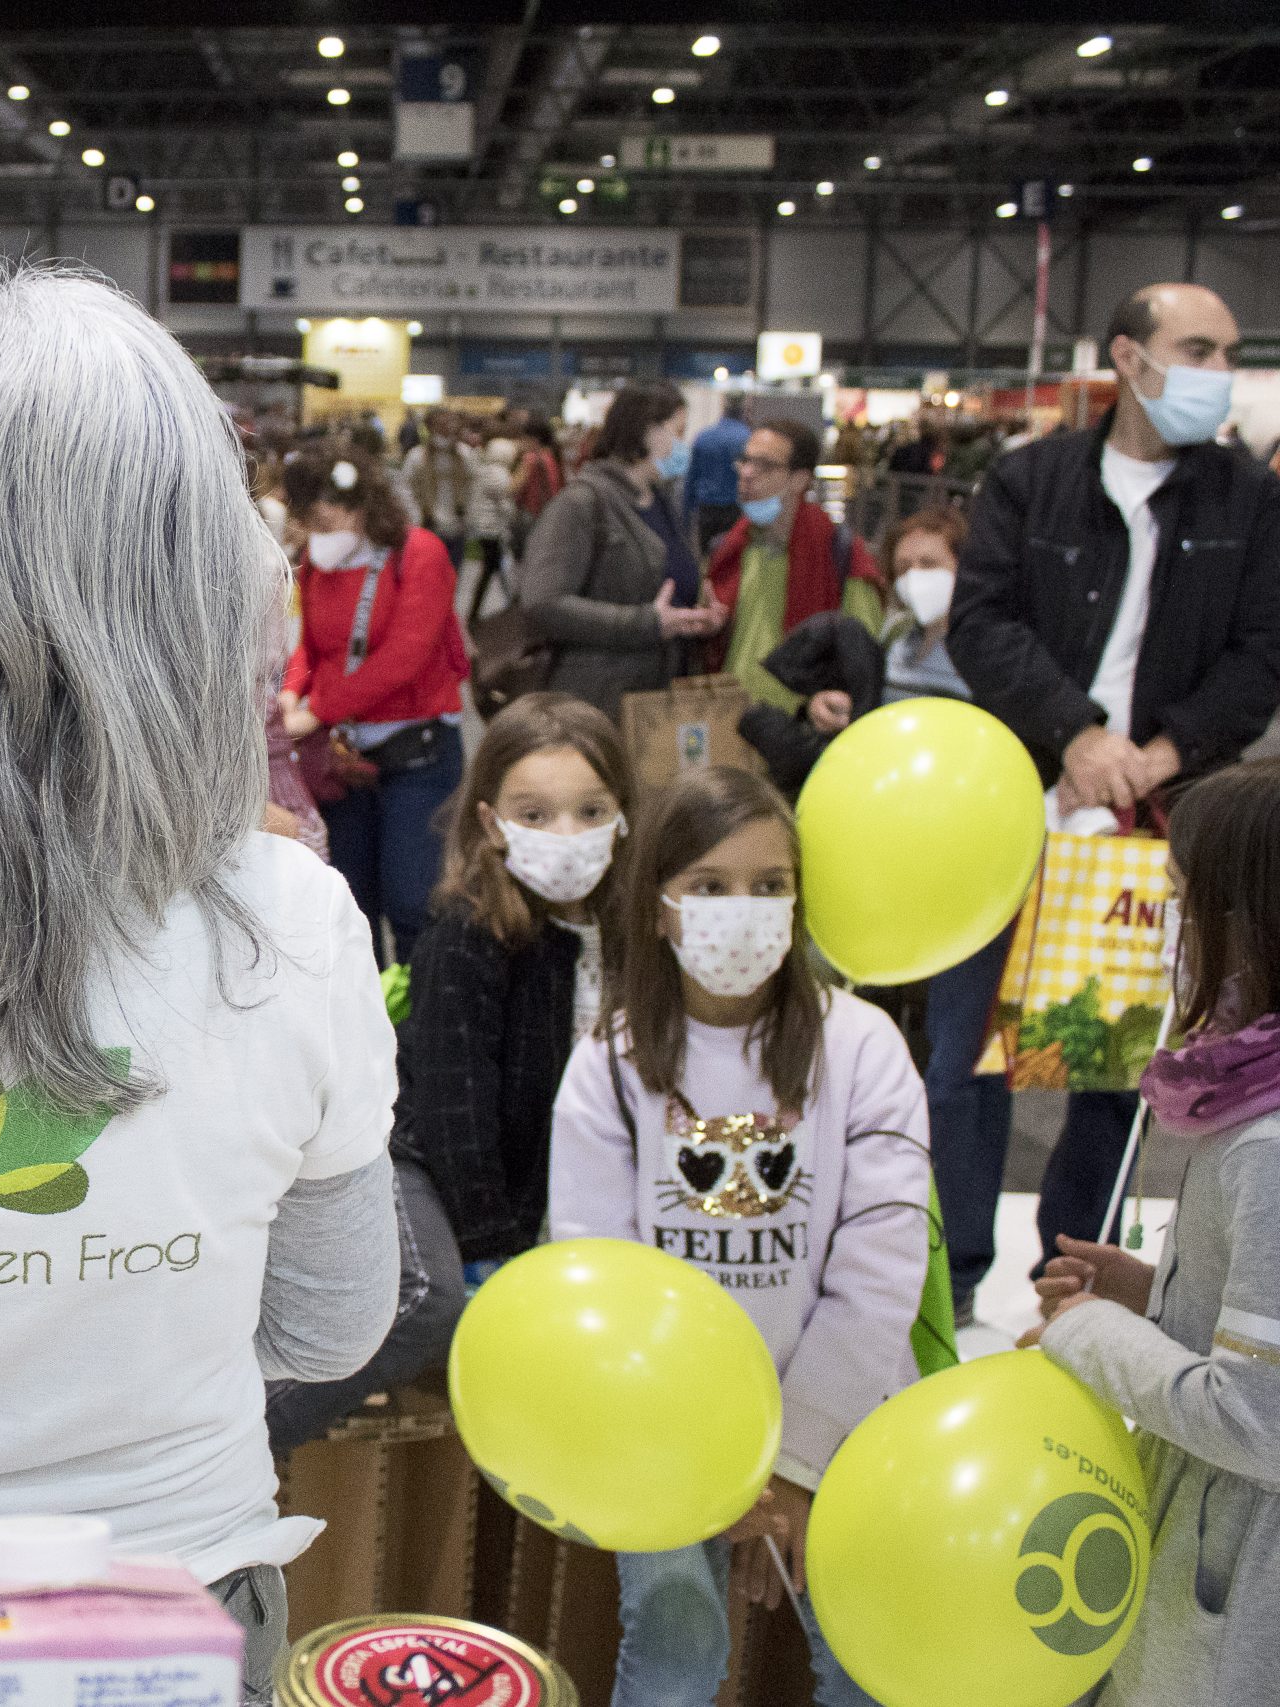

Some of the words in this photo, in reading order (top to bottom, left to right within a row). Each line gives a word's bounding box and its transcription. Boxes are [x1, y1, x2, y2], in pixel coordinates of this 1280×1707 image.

[439, 63, 466, 100] 9
[477, 240, 669, 268] Restaurante
[486, 272, 637, 299] Restaurant
[78, 1231, 202, 1282] Frog
[705, 1267, 791, 1290] RREAT
